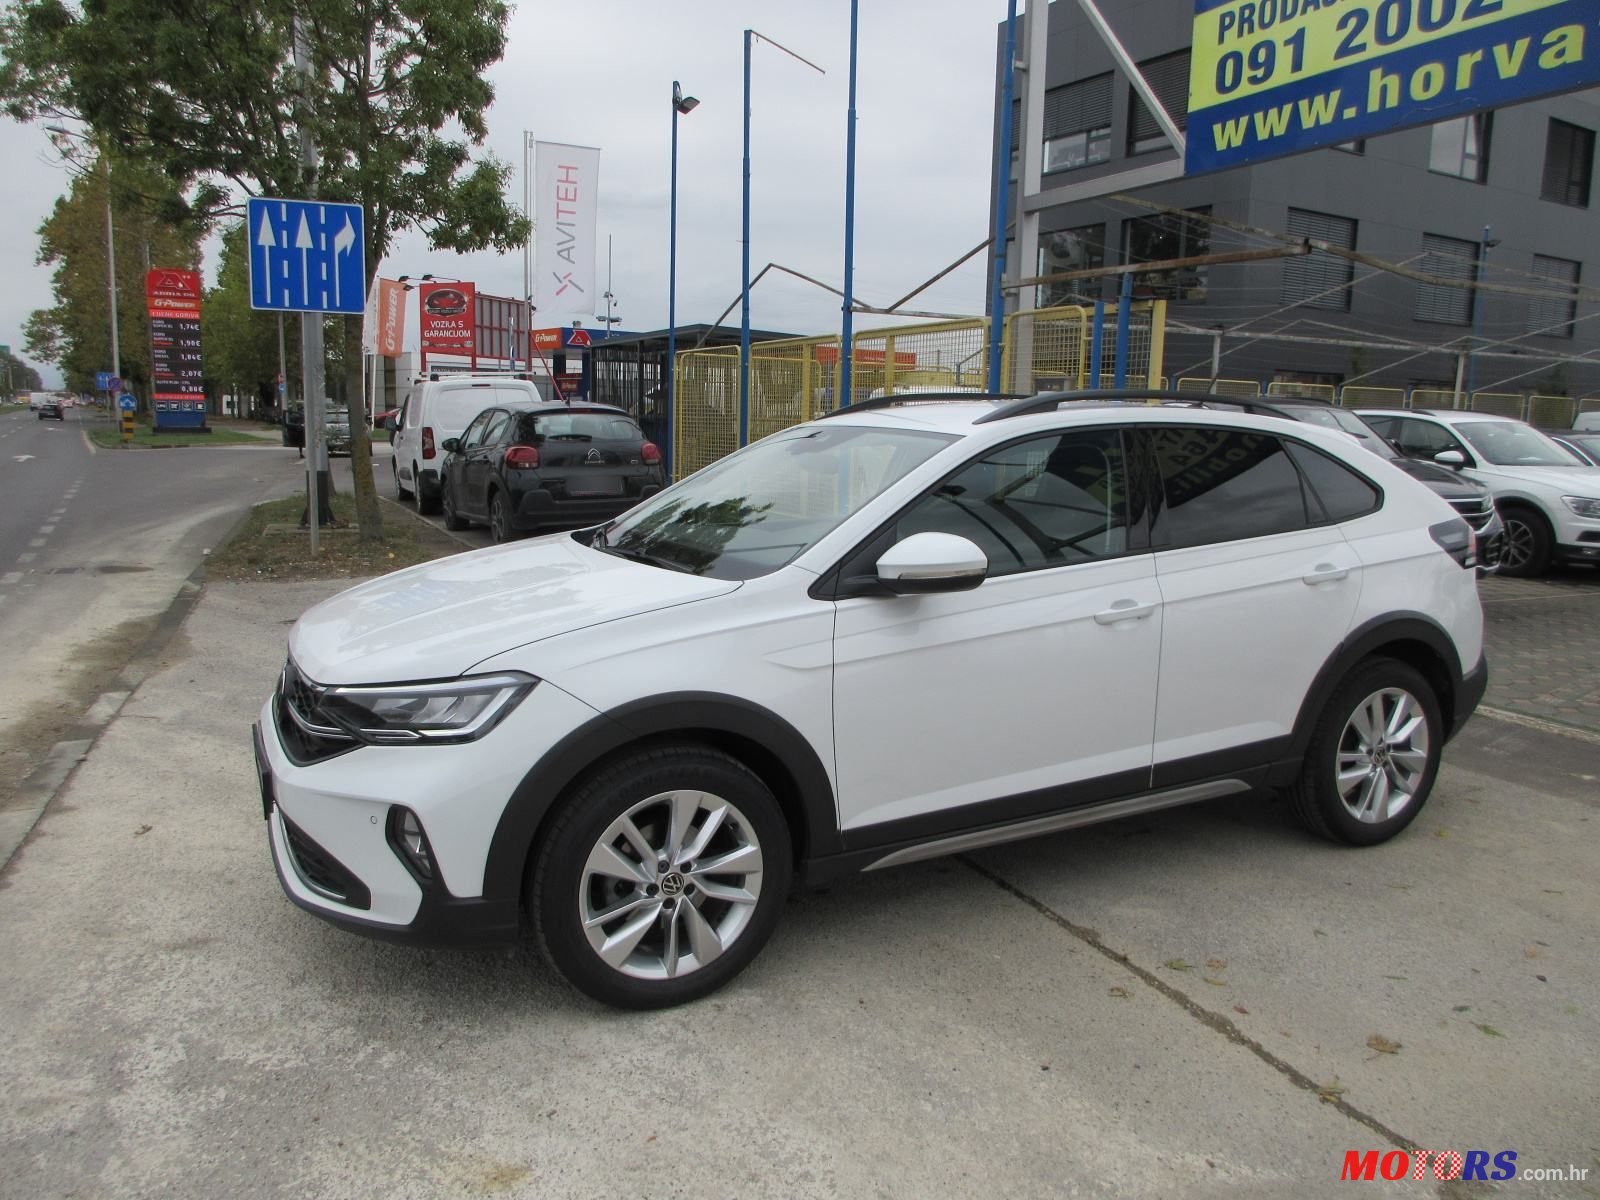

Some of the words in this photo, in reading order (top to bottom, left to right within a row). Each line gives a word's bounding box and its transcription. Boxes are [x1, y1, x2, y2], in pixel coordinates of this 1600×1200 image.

[1212, 18, 1600, 152] www.horva
[1215, 28, 1305, 95] 091
[556, 165, 578, 264] AVITEH
[430, 320, 456, 328] VOZILA
[458, 320, 464, 328] S
